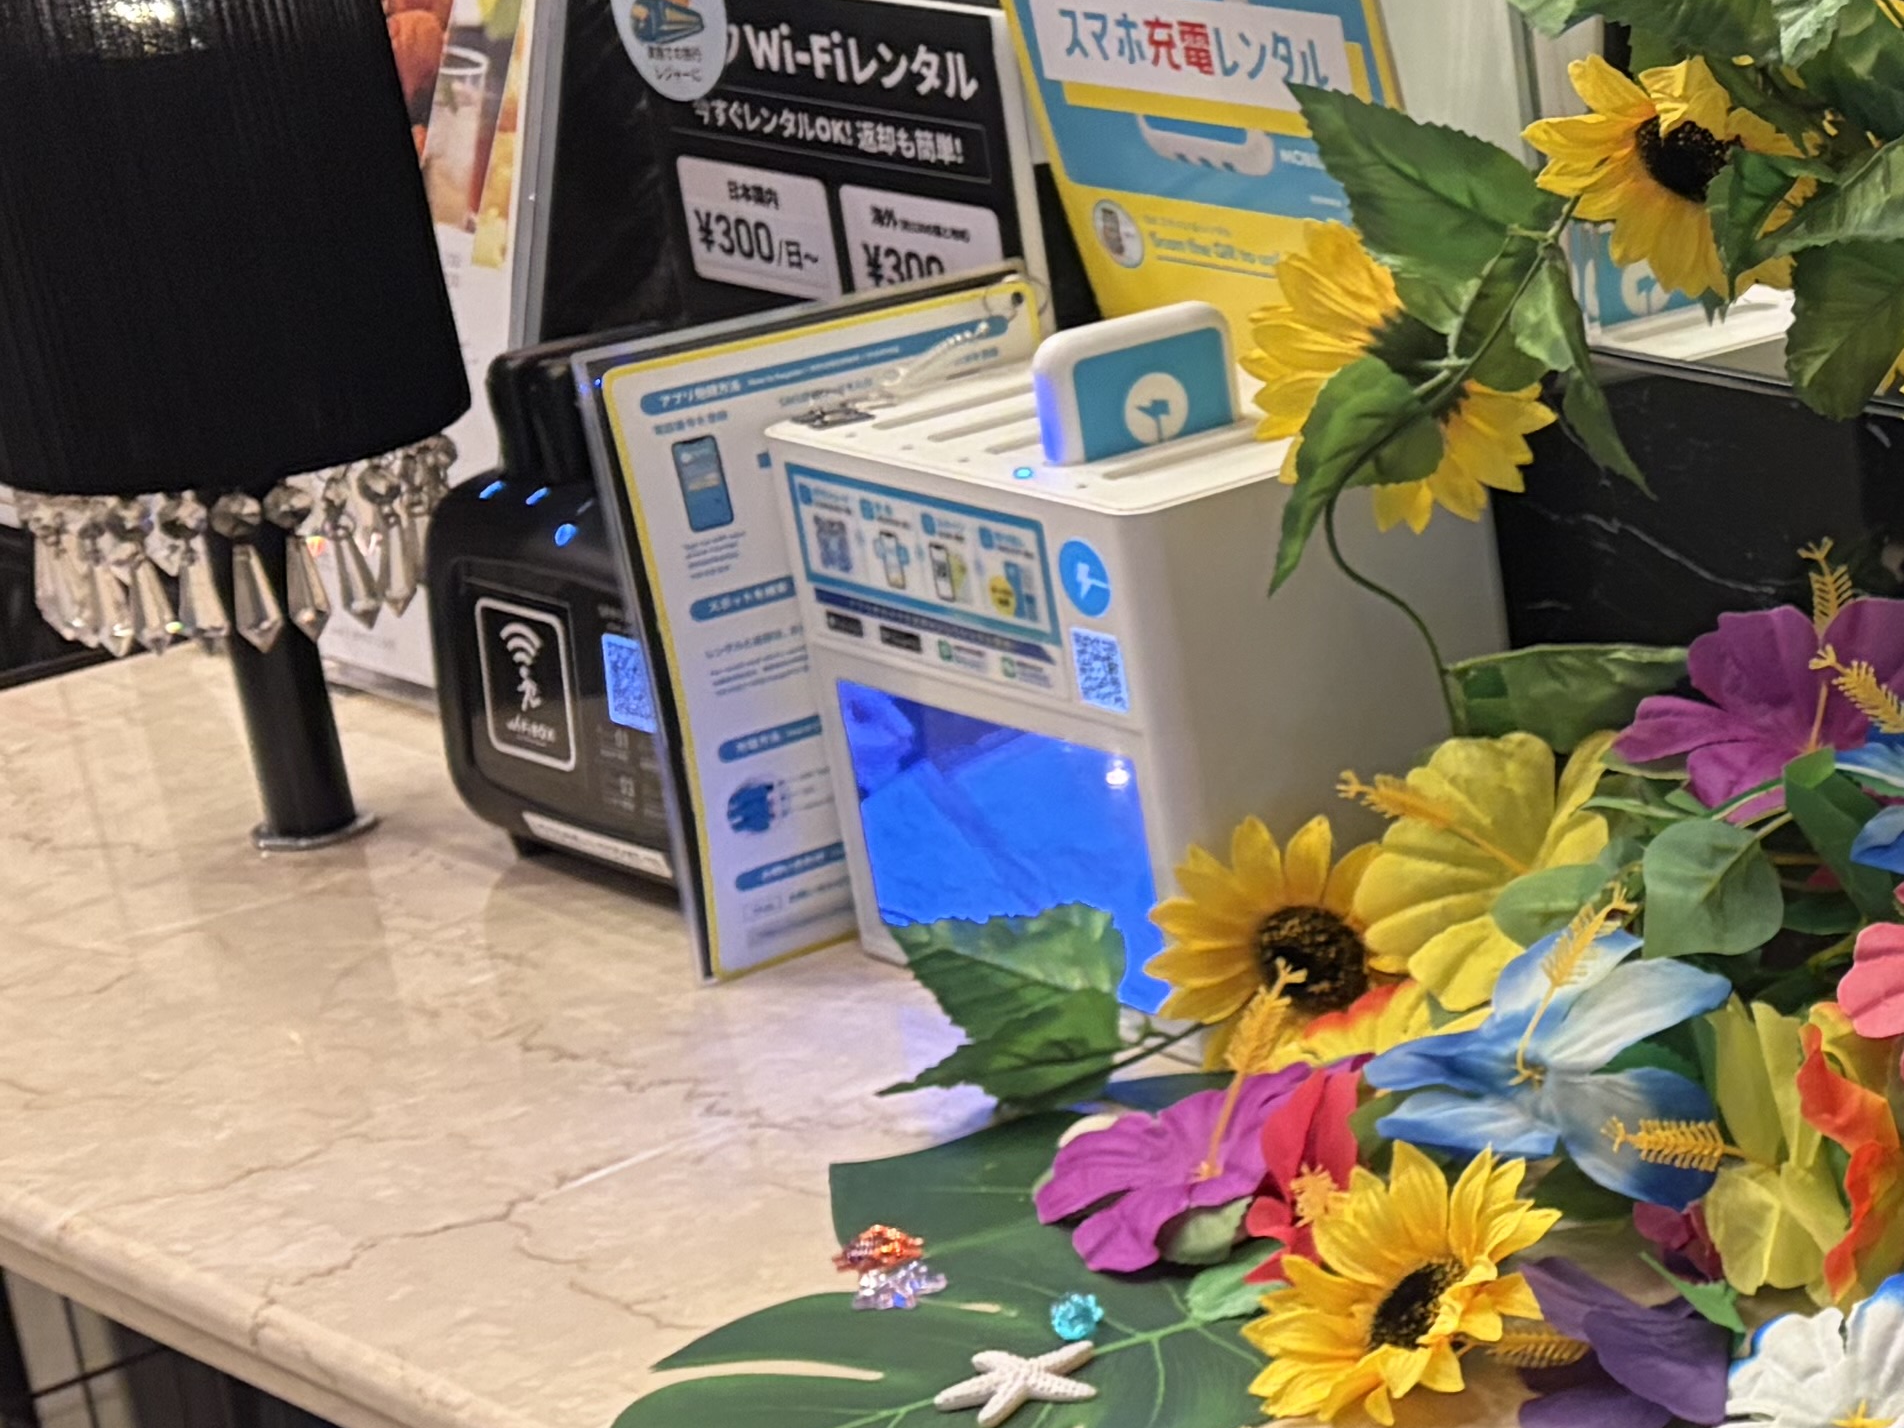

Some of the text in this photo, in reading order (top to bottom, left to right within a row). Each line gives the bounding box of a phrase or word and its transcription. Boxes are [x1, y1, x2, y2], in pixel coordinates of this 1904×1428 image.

[1058, 7, 1330, 87] スマホ充電レンタル
[856, 119, 964, 165] 返却も簡単!
